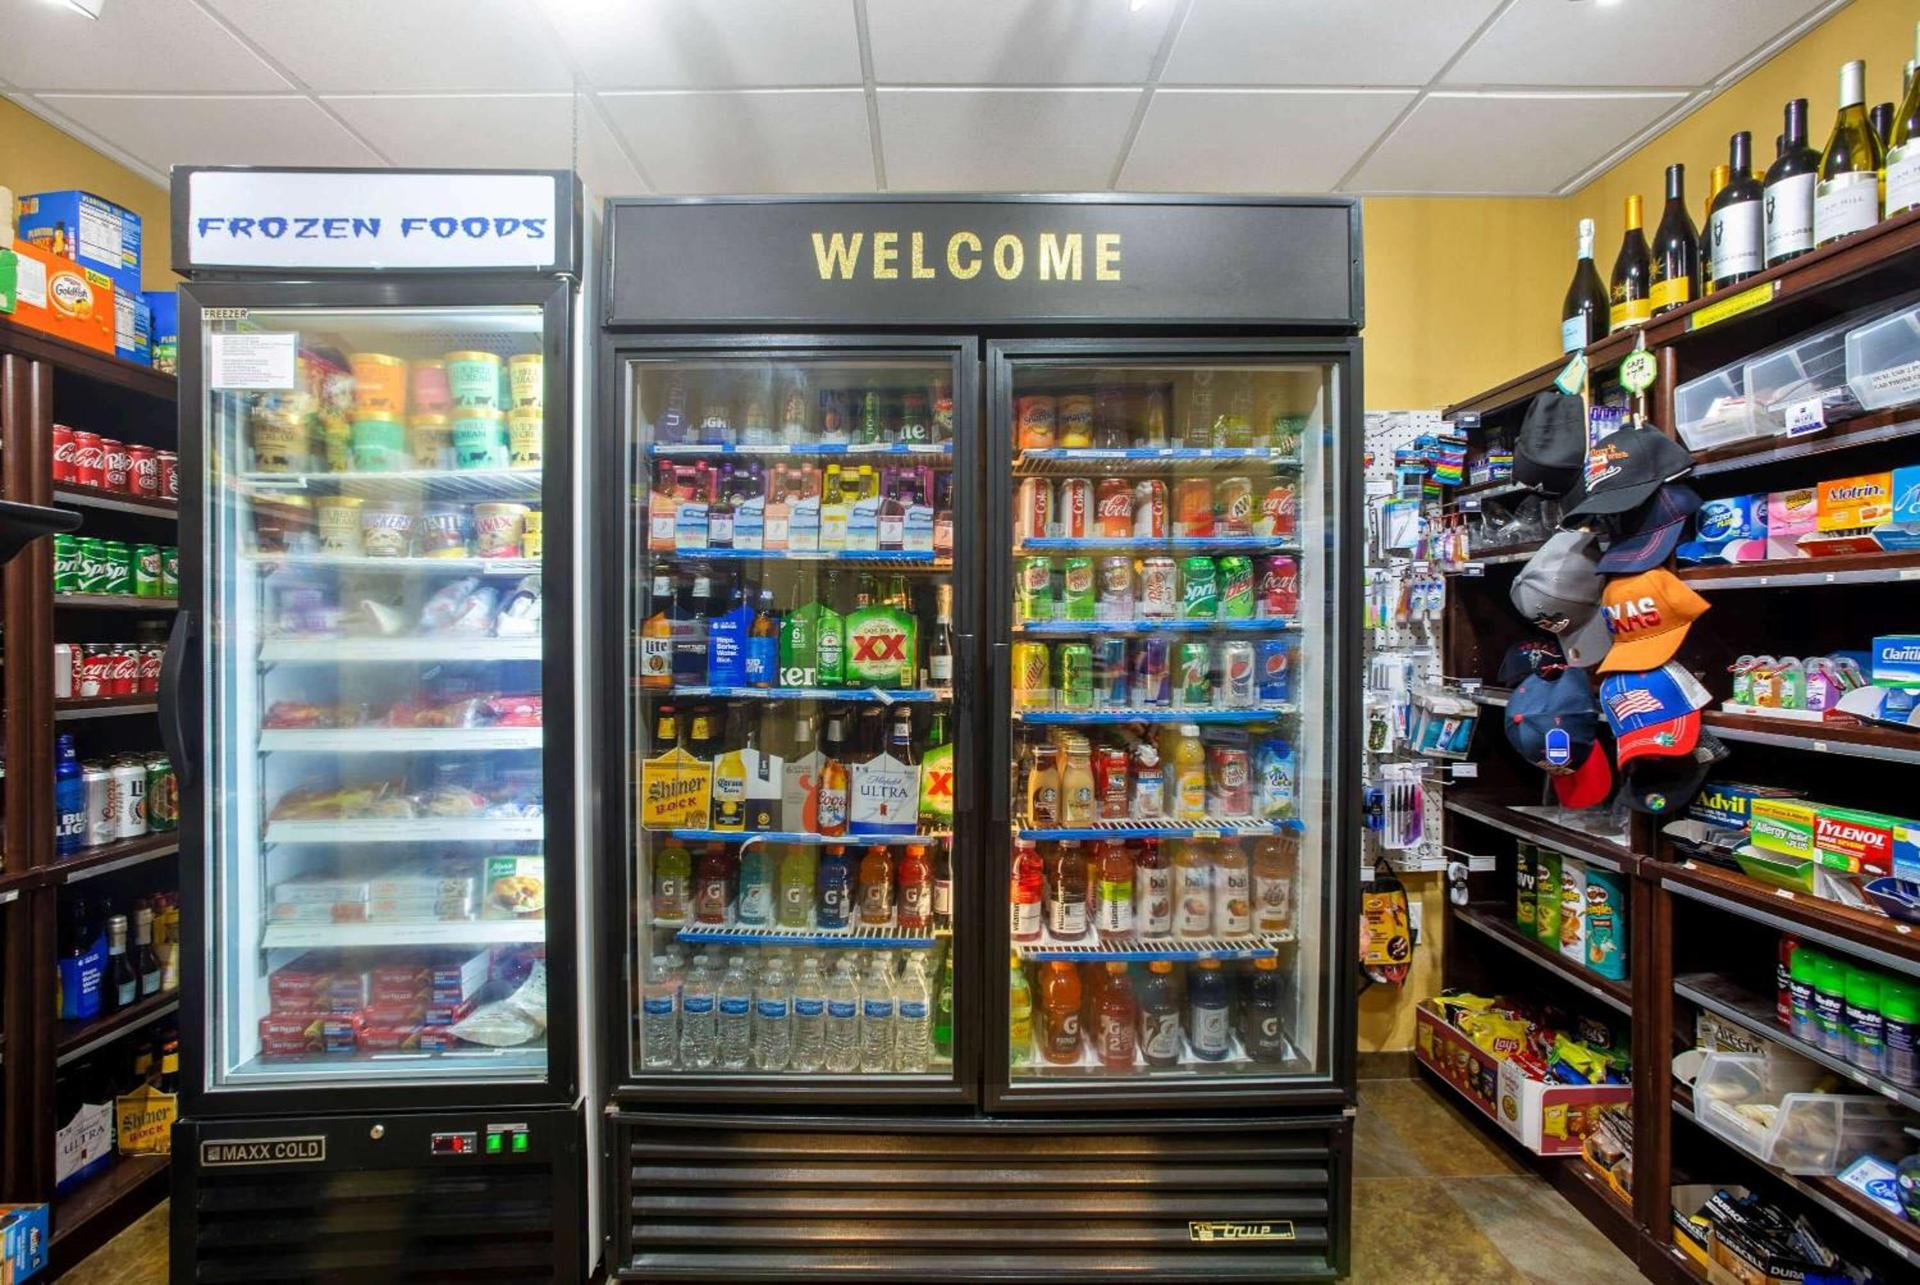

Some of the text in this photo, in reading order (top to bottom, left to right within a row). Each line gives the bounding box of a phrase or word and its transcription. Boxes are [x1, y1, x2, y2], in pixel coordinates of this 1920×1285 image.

[197, 216, 547, 240] FROZEN FOODS
[811, 231, 1121, 281] WELCOME
[56, 284, 88, 299] Goldfish
[204, 310, 248, 320] FREEZER
[1829, 485, 1879, 501] Motrin
[1186, 583, 1217, 601] Spri
[645, 638, 668, 654] Lite
[853, 634, 907, 661] XX
[1882, 648, 1920, 662] Clariti
[648, 776, 707, 803] Shiner
[860, 785, 908, 798] ULTRA
[655, 797, 697, 815] BOCK
[1699, 789, 1746, 814] Advil
[62, 813, 86, 825] BU
[56, 823, 84, 836] LIG
[1755, 821, 1787, 839] Allergy
[1816, 818, 1888, 847] TYLENOL
[824, 890, 837, 905] G
[1063, 1016, 1079, 1036] G
[64, 1125, 106, 1155] ULTRA
[222, 1141, 319, 1161] MAXX COLD
[1711, 1195, 1748, 1225] DURACE
[1716, 1231, 1766, 1271] DURACELL
[1770, 1265, 1805, 1280] DURA
